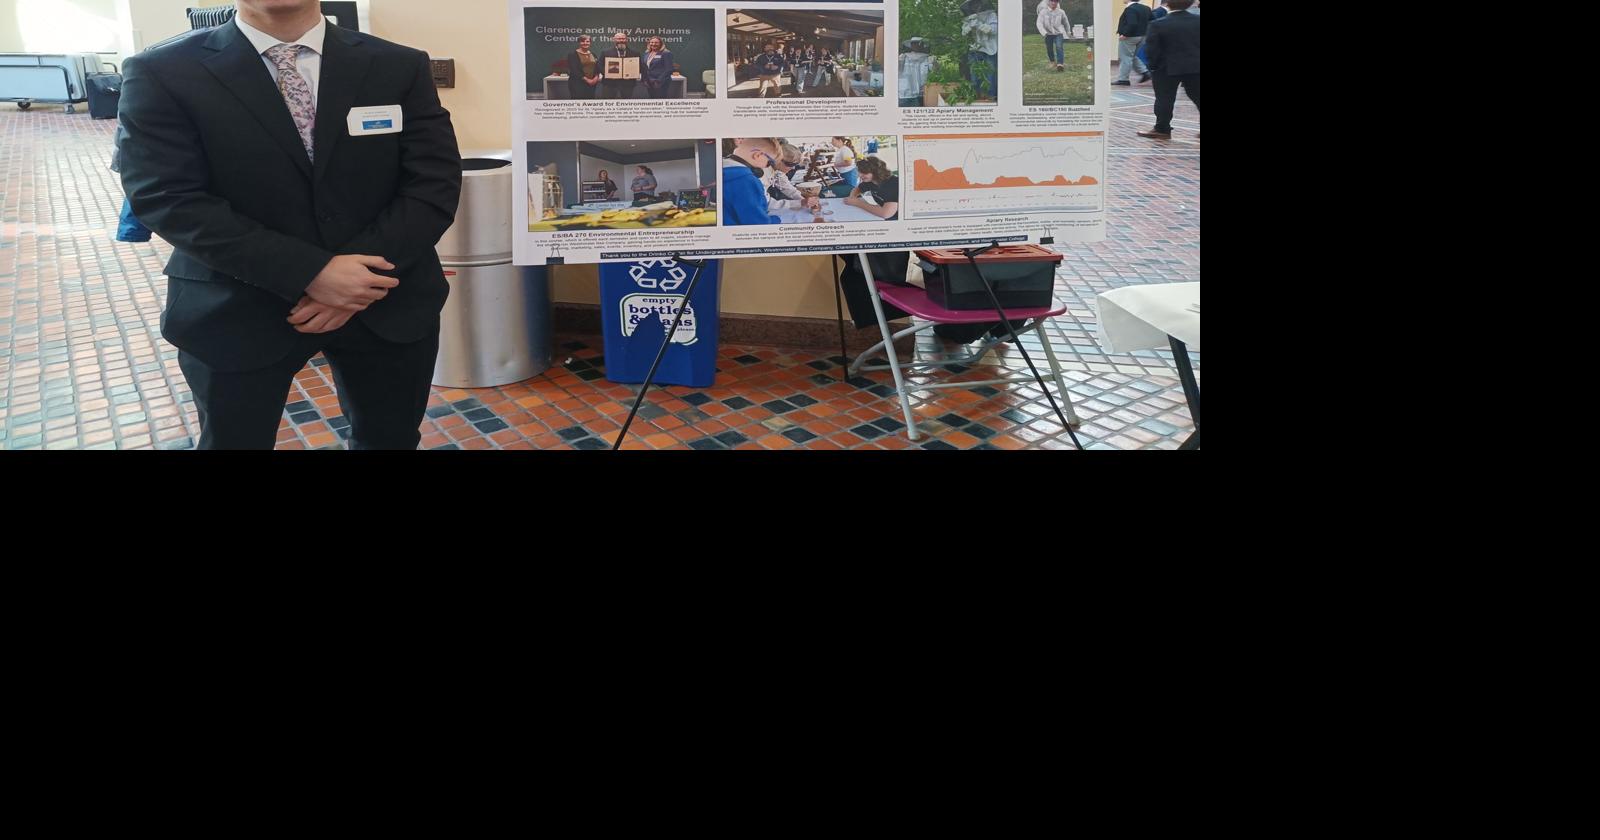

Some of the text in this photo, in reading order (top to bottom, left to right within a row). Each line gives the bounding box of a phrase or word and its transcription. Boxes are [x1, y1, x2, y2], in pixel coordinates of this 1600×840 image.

[535, 26, 691, 36] Clarence and Mary Ann Harms
[544, 34, 579, 42] Center
[638, 229, 695, 237] Entrepreneurship
[779, 225, 815, 233] Community
[628, 304, 692, 315] bottles
[629, 314, 641, 325] &
